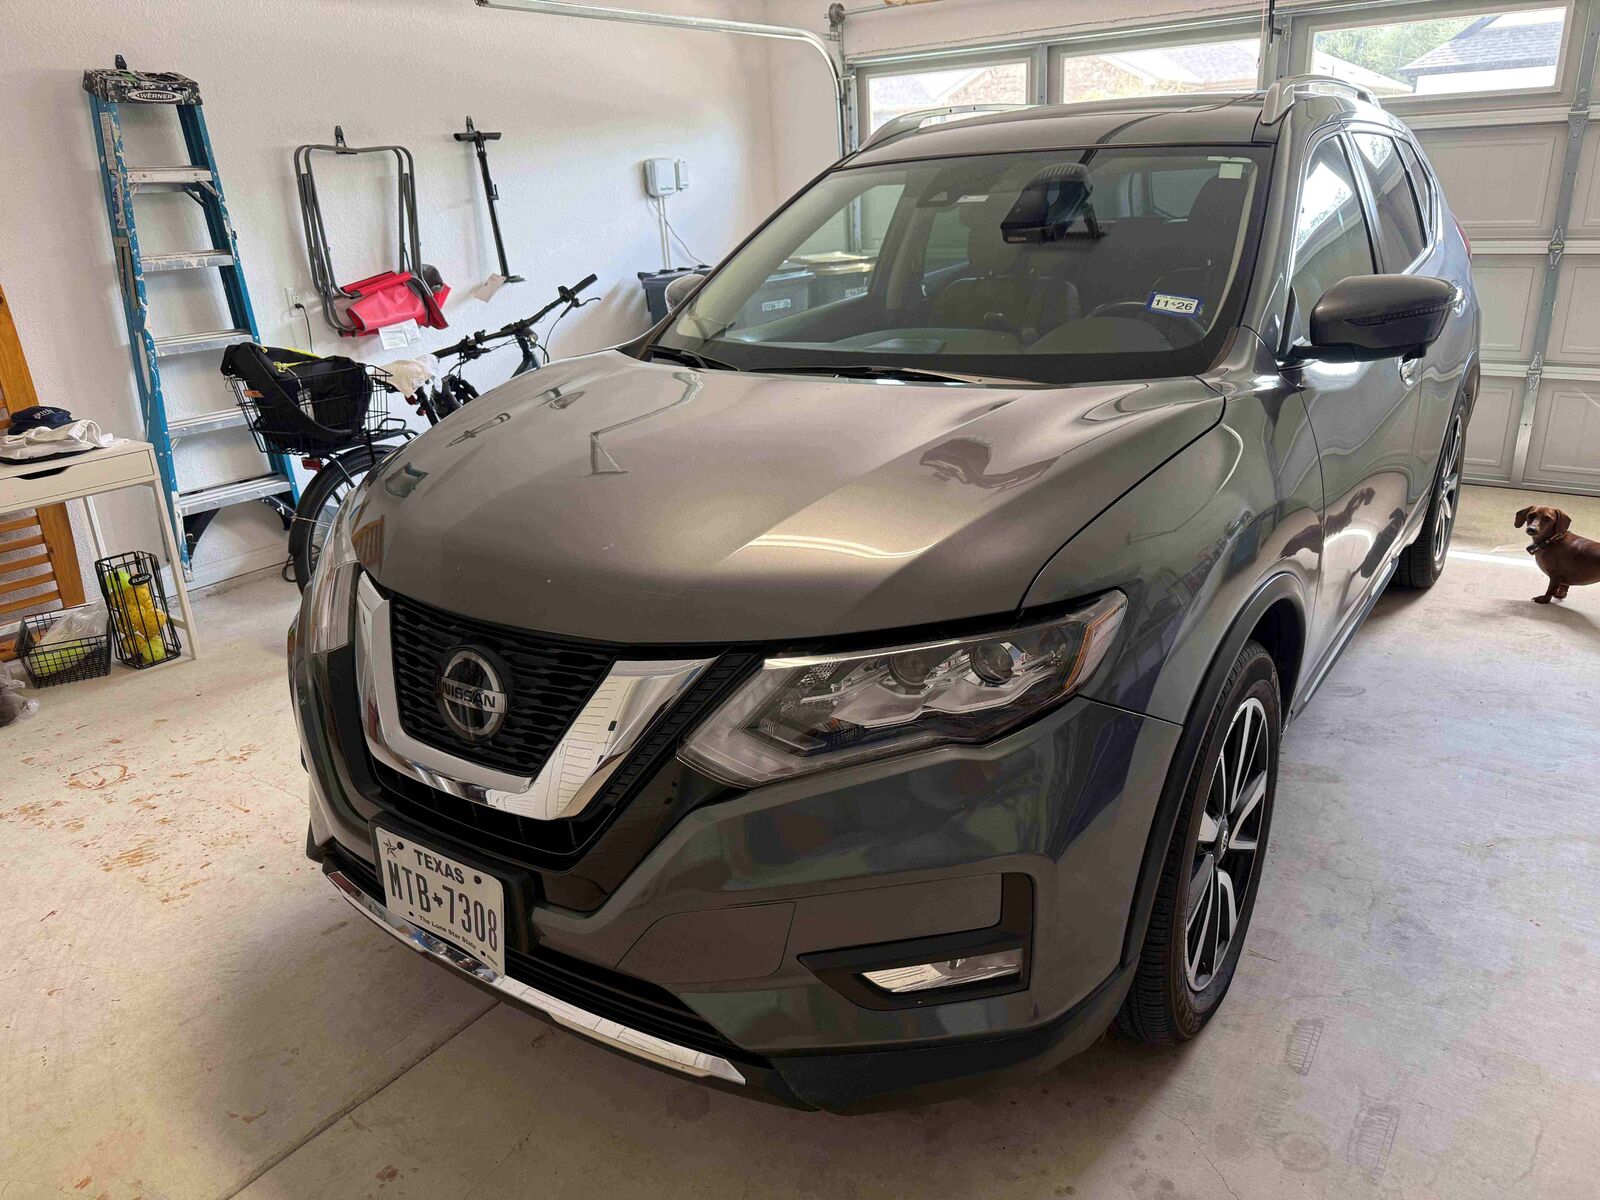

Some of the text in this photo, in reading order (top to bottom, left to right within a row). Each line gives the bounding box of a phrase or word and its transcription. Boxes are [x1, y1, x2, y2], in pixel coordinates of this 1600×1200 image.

[139, 92, 174, 100] WERNER
[442, 681, 496, 708] NISSAN
[413, 848, 465, 884] TEXAS
[418, 914, 430, 925] The
